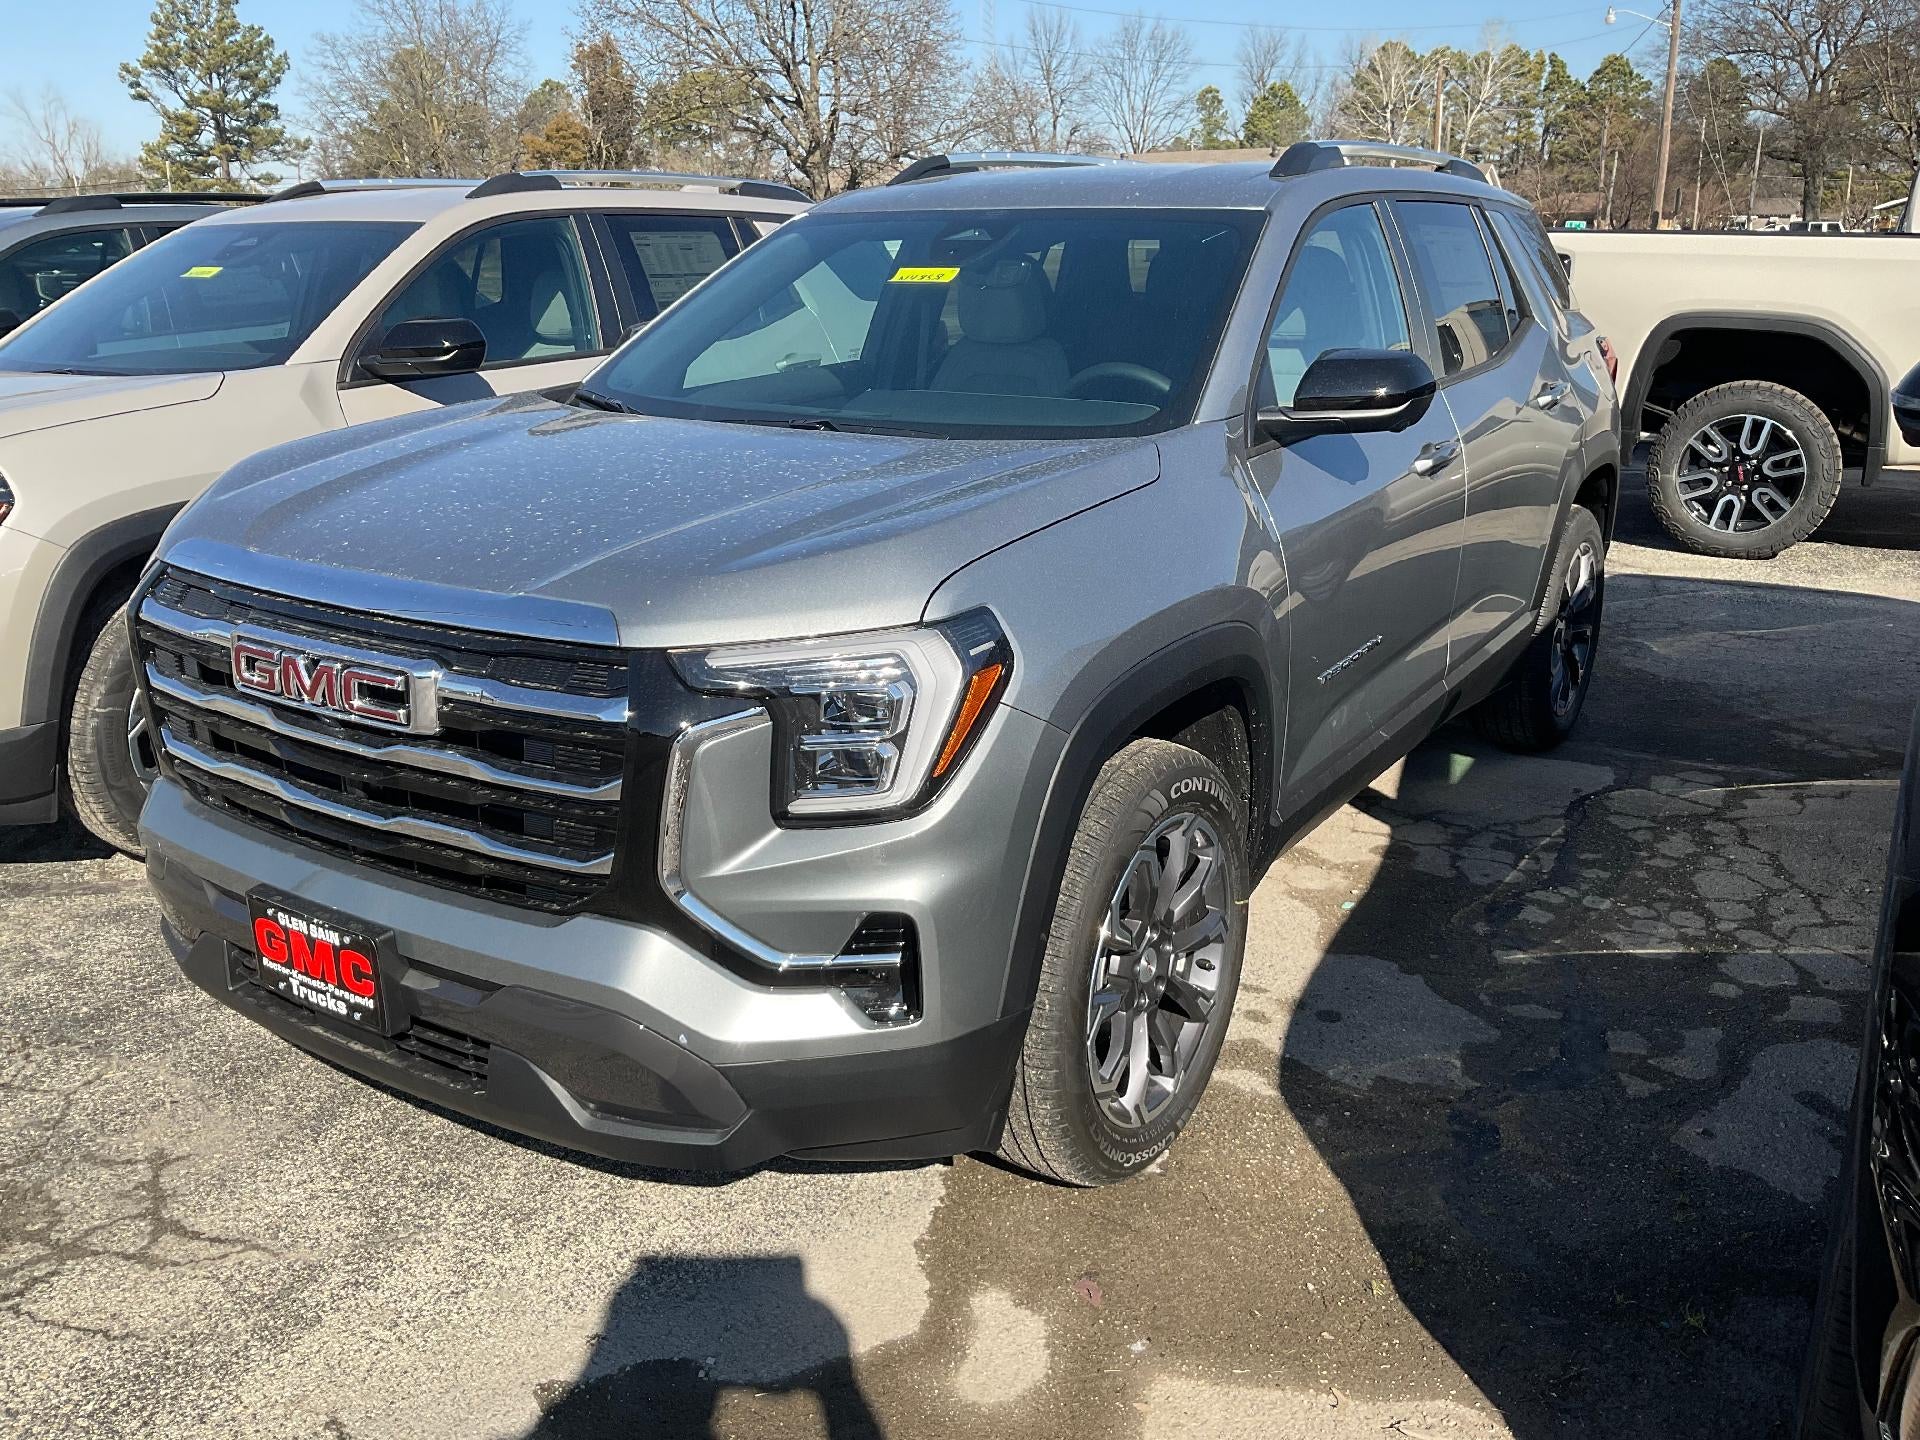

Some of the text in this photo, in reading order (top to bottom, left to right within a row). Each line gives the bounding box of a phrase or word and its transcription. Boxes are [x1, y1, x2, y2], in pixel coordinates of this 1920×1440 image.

[233, 641, 408, 724] GMC
[255, 917, 375, 997] GMC
[277, 911, 341, 947] GLEN SAIN
[288, 977, 348, 1015] Trucks
